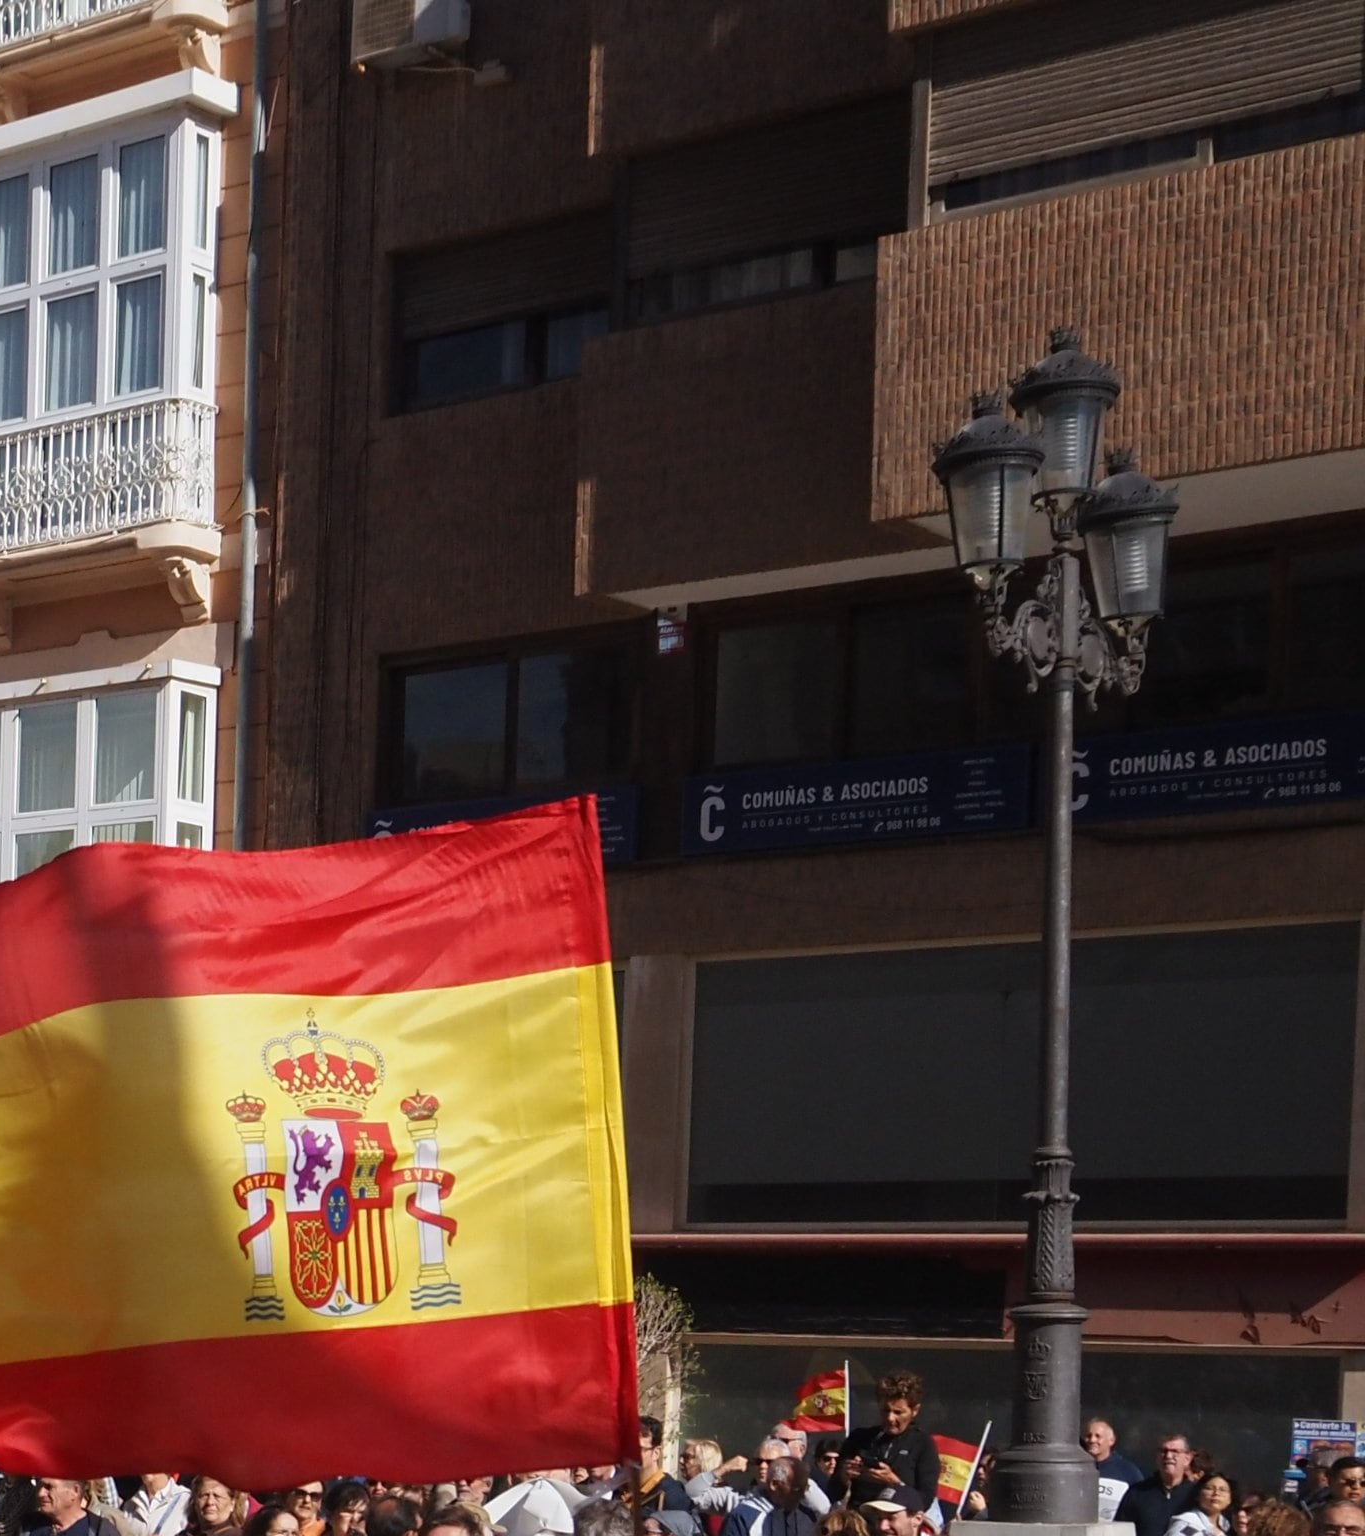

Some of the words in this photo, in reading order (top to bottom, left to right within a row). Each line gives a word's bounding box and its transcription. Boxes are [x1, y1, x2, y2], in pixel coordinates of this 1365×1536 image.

[1110, 751, 1195, 776] COMUÑAS
[1203, 750, 1217, 768] &
[1224, 738, 1327, 766] ASOCIADOS
[741, 785, 816, 809] COMUÑAS
[822, 785, 835, 802] &
[840, 776, 929, 801] ASOCIADOS
[1110, 782, 1188, 798] ABOGADOS
[1198, 780, 1205, 790] Y
[1214, 769, 1328, 788] CONSULTORES
[1300, 784, 1310, 795] 11
[741, 815, 811, 830] ABOGADOS
[817, 814, 824, 822] Y
[831, 805, 929, 822] CONSULTORES
[886, 819, 903, 831] 968
[905, 819, 913, 829] 11
